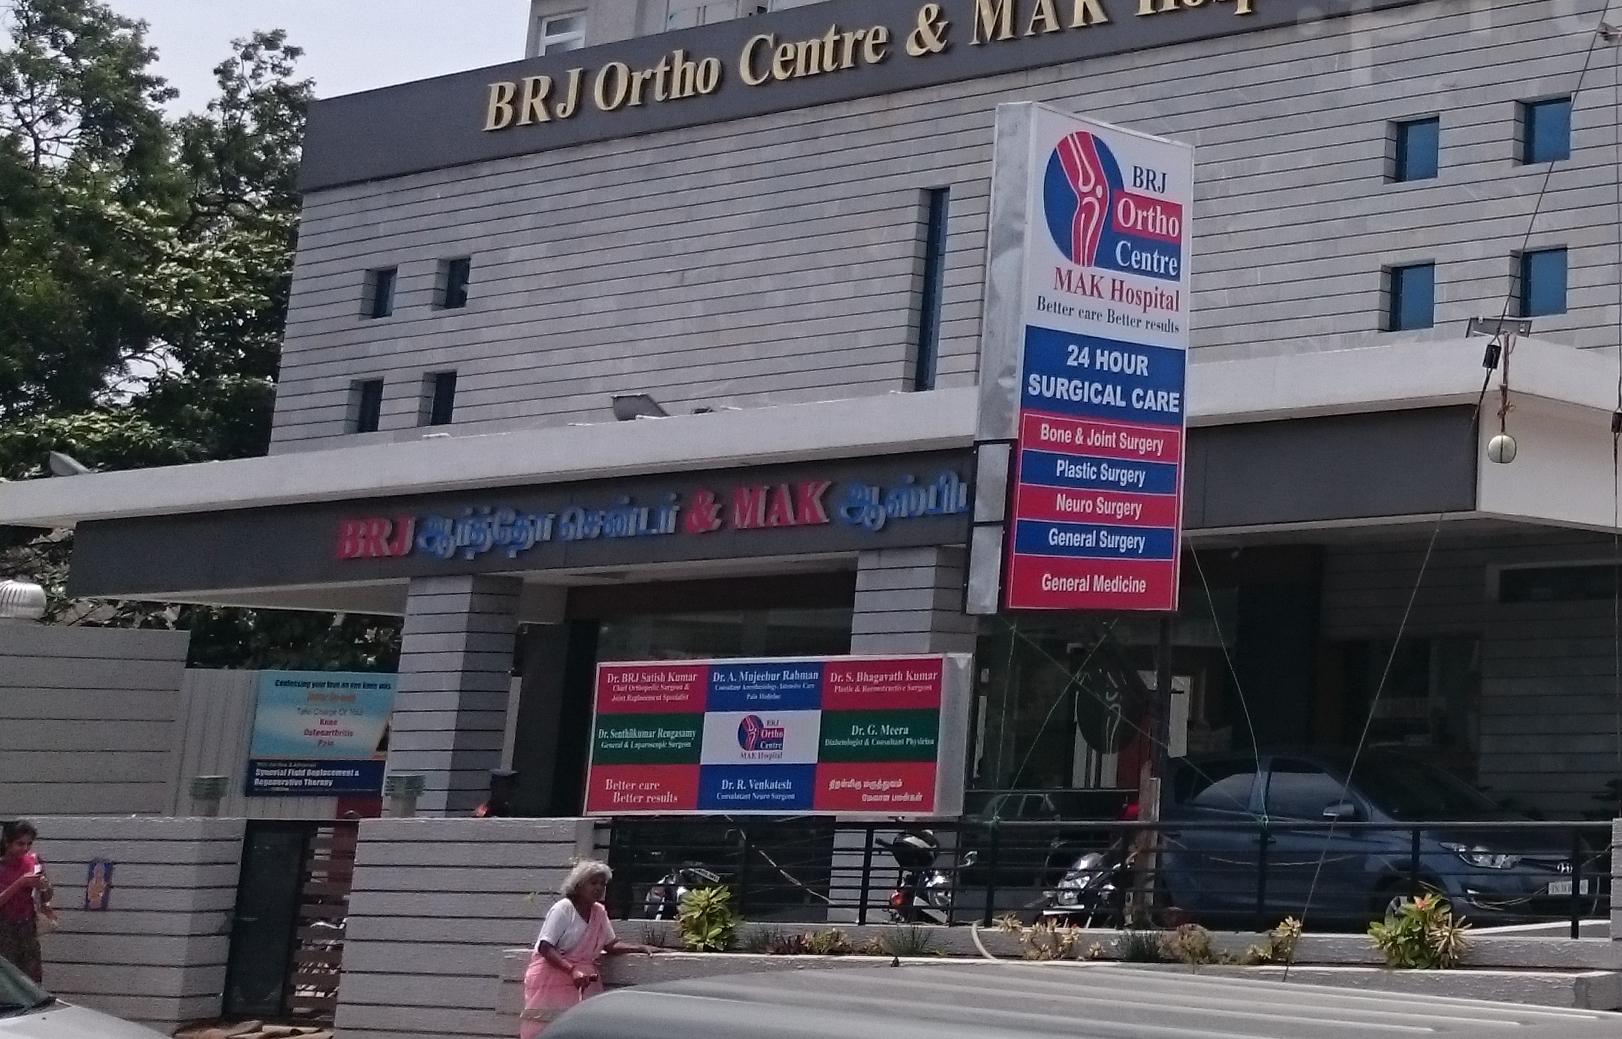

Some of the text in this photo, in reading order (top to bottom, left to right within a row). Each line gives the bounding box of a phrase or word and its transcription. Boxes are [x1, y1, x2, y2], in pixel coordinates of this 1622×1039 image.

[482, 67, 584, 131] BRJ
[594, 50, 722, 112] Ortho
[740, 24, 890, 87] Centre
[906, 3, 949, 58] &
[1132, 165, 1167, 194] BRJ
[1117, 197, 1180, 238] Ortho
[1115, 240, 1178, 276] Centre
[1054, 267, 1180, 314] MAK Hospital
[1037, 295, 1180, 334] Better care Better results
[1066, 344, 1149, 377] 24 HOUR
[1028, 374, 1180, 413] SURGICAL CARE
[1040, 423, 1164, 456] Bone & Joint Surgery
[1056, 459, 1146, 487] Plastic Surgery
[336, 516, 416, 559] BRJ
[686, 487, 723, 534] &
[732, 480, 832, 529] MAK
[1056, 493, 1142, 520] Neuro Surgery
[1048, 528, 1146, 553] General Surgery
[1041, 573, 1147, 593] General Medicine
[607, 672, 698, 683] Dr. BRJ Satish Kumar
[713, 671, 726, 682] Dr.
[726, 671, 737, 682] A.
[782, 669, 819, 680] Rahman
[830, 672, 844, 682] Dr.
[845, 672, 855, 682] S.
[905, 670, 938, 681] Kumar
[761, 729, 784, 738] Ortho
[851, 725, 865, 736] Dr.
[881, 724, 909, 735] Meera
[605, 778, 660, 790] Better care
[613, 791, 678, 803] Better results
[721, 779, 792, 790] Dr. R. Venkatesh
